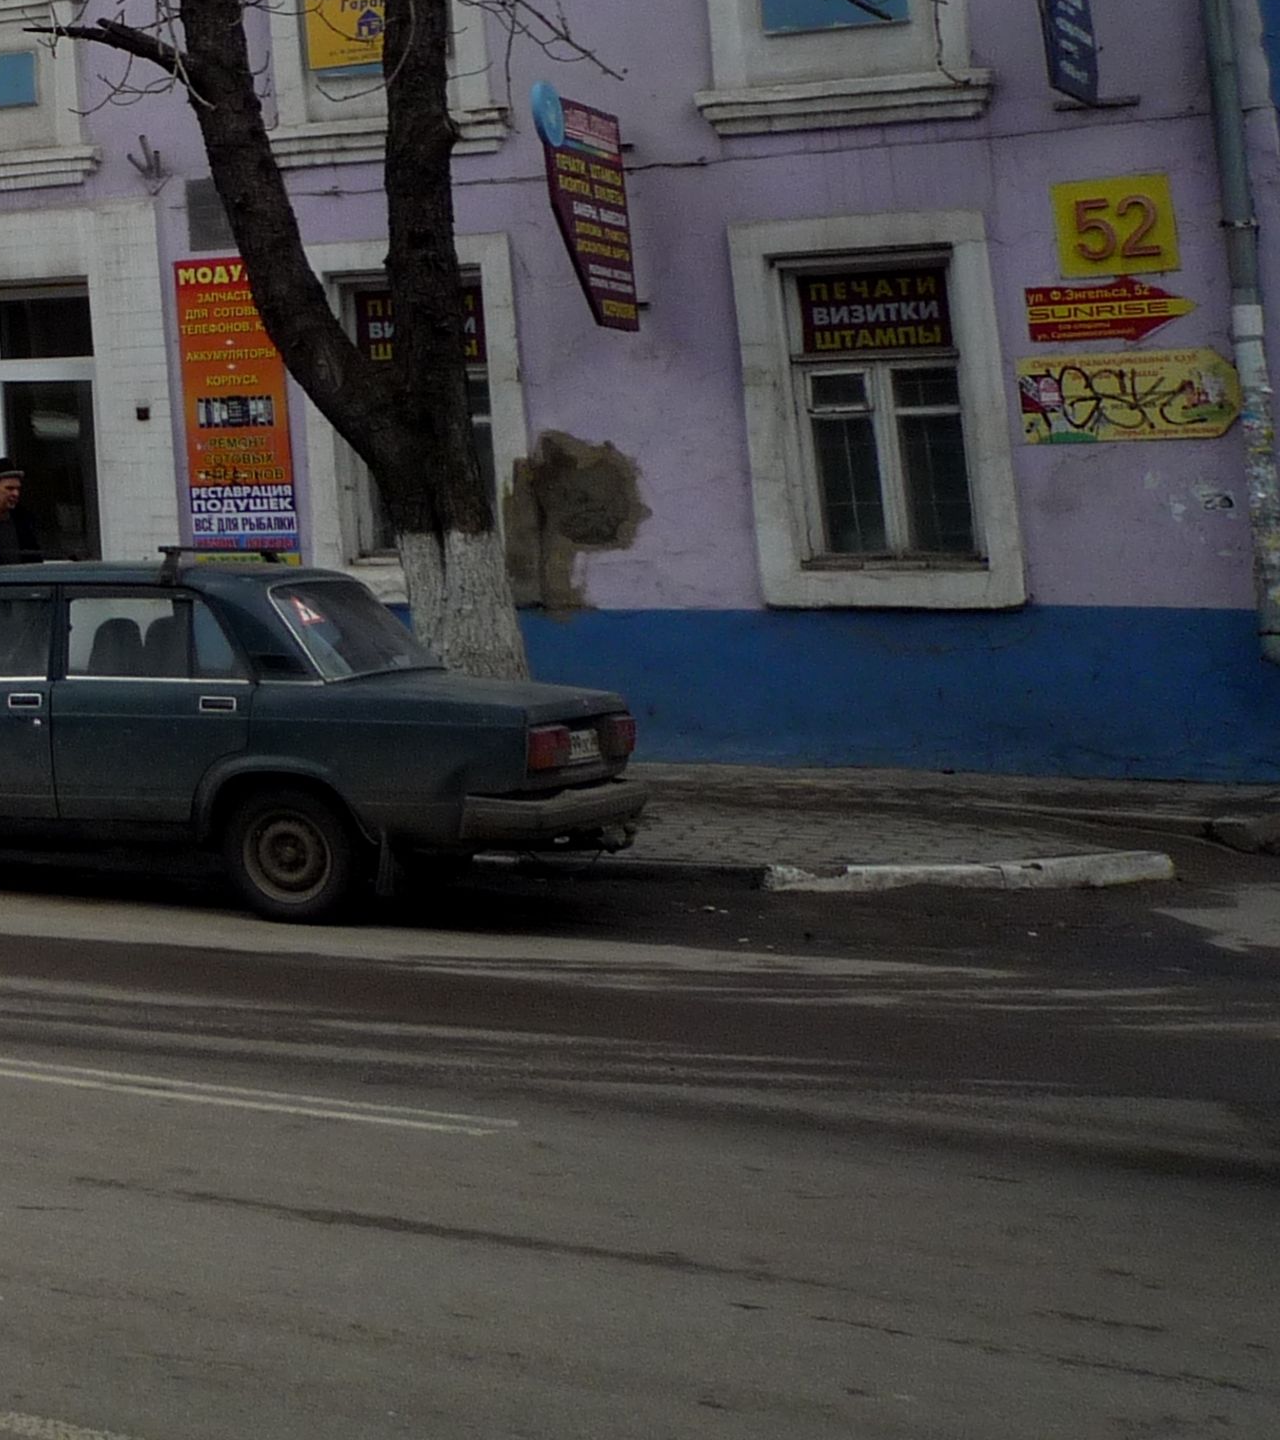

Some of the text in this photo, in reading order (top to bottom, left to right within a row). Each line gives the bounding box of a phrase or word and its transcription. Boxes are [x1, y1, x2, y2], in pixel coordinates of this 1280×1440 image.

[1075, 194, 1161, 261] 52
[178, 265, 248, 286] МОДУ
[809, 275, 937, 302] ПЕЧАТИ
[1134, 284, 1150, 296] 52
[185, 308, 208, 320] ДЛЯ
[812, 300, 940, 326] ВИЗИТКИ
[1029, 301, 1169, 321] SUNRISE
[814, 325, 942, 350] ШТАМПЫ
[186, 346, 277, 362] АККУМУЛЯТОРЫ
[206, 374, 259, 386] КОРПУСА
[208, 437, 265, 449] РЕМОНТ
[203, 452, 274, 465] СОТОВЫХ
[192, 484, 293, 499] РЕСТАВРАЦИЯ
[193, 497, 294, 513] ПОДУШЕК
[218, 518, 238, 533] ДЛЯ
[241, 516, 296, 532] РЫБАЛКИ
